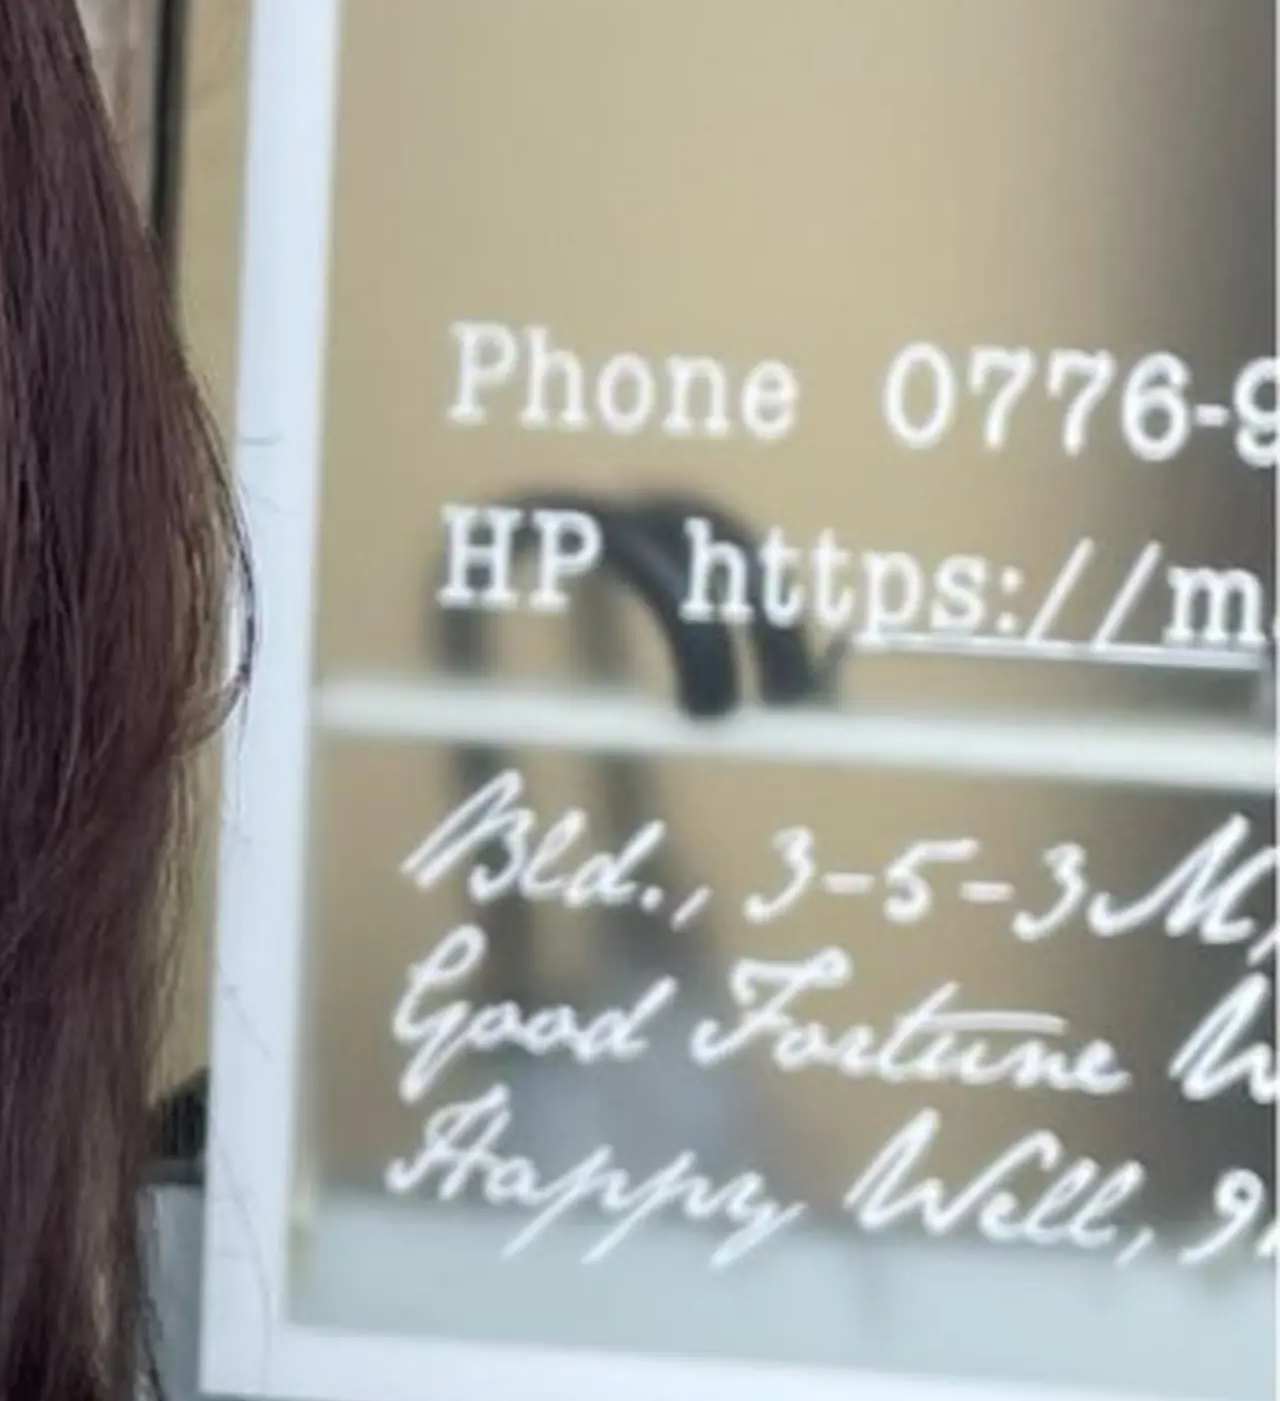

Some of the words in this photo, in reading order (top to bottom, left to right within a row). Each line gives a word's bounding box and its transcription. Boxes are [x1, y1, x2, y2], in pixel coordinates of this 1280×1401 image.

[450, 321, 799, 439] Phone
[437, 503, 603, 614] HP
[680, 517, 1277, 653] https://m
[391, 923, 679, 1104] Good
[688, 945, 1132, 1095] Fortune
[383, 1082, 807, 1270] Happy
